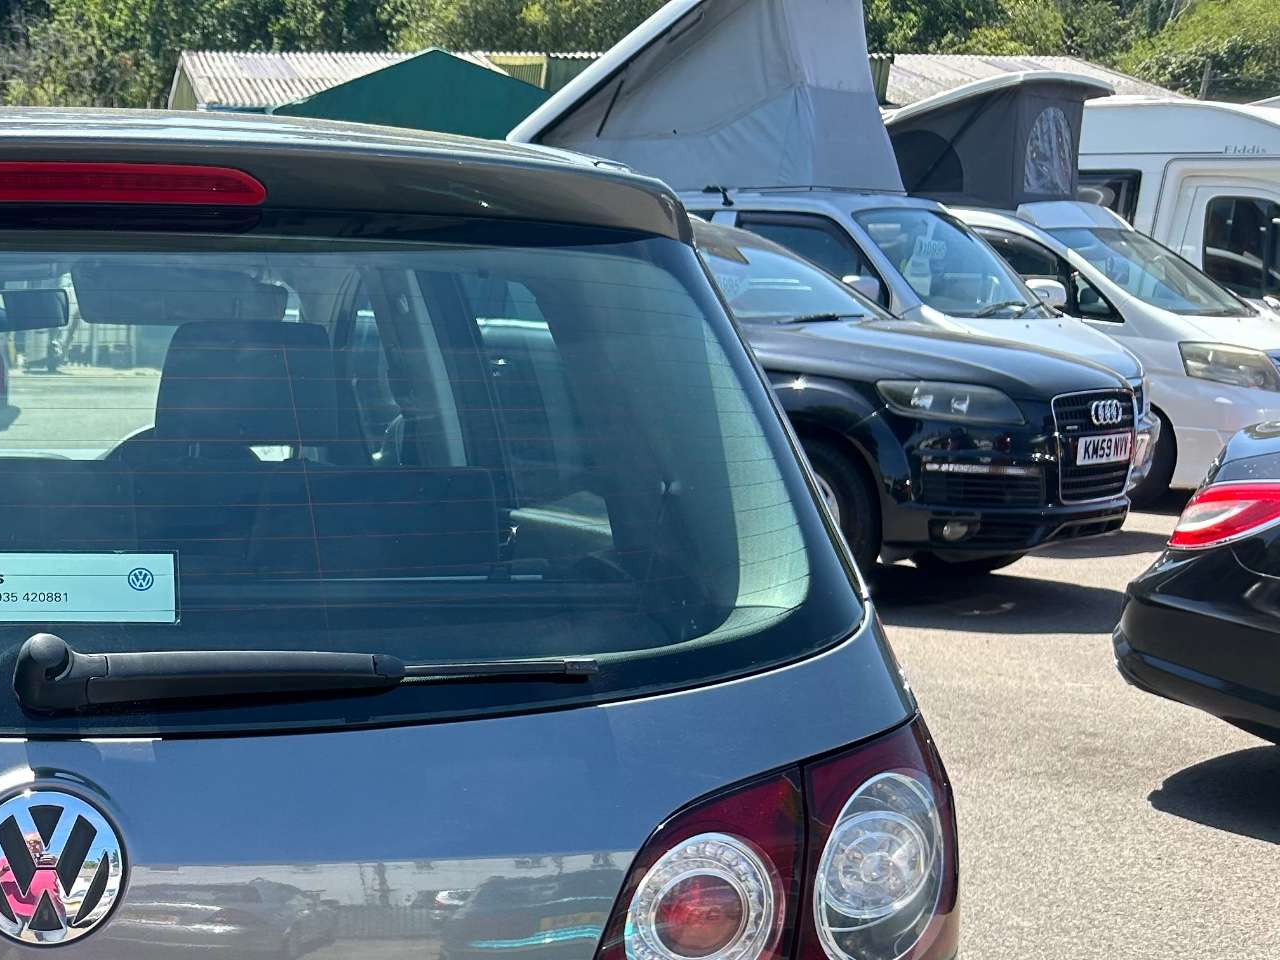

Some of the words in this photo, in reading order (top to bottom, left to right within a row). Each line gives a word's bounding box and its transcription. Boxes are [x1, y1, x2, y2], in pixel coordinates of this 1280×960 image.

[1224, 144, 1267, 154] Elddis
[1083, 438, 1113, 460] KM59
[22, 592, 69, 603] 420881
